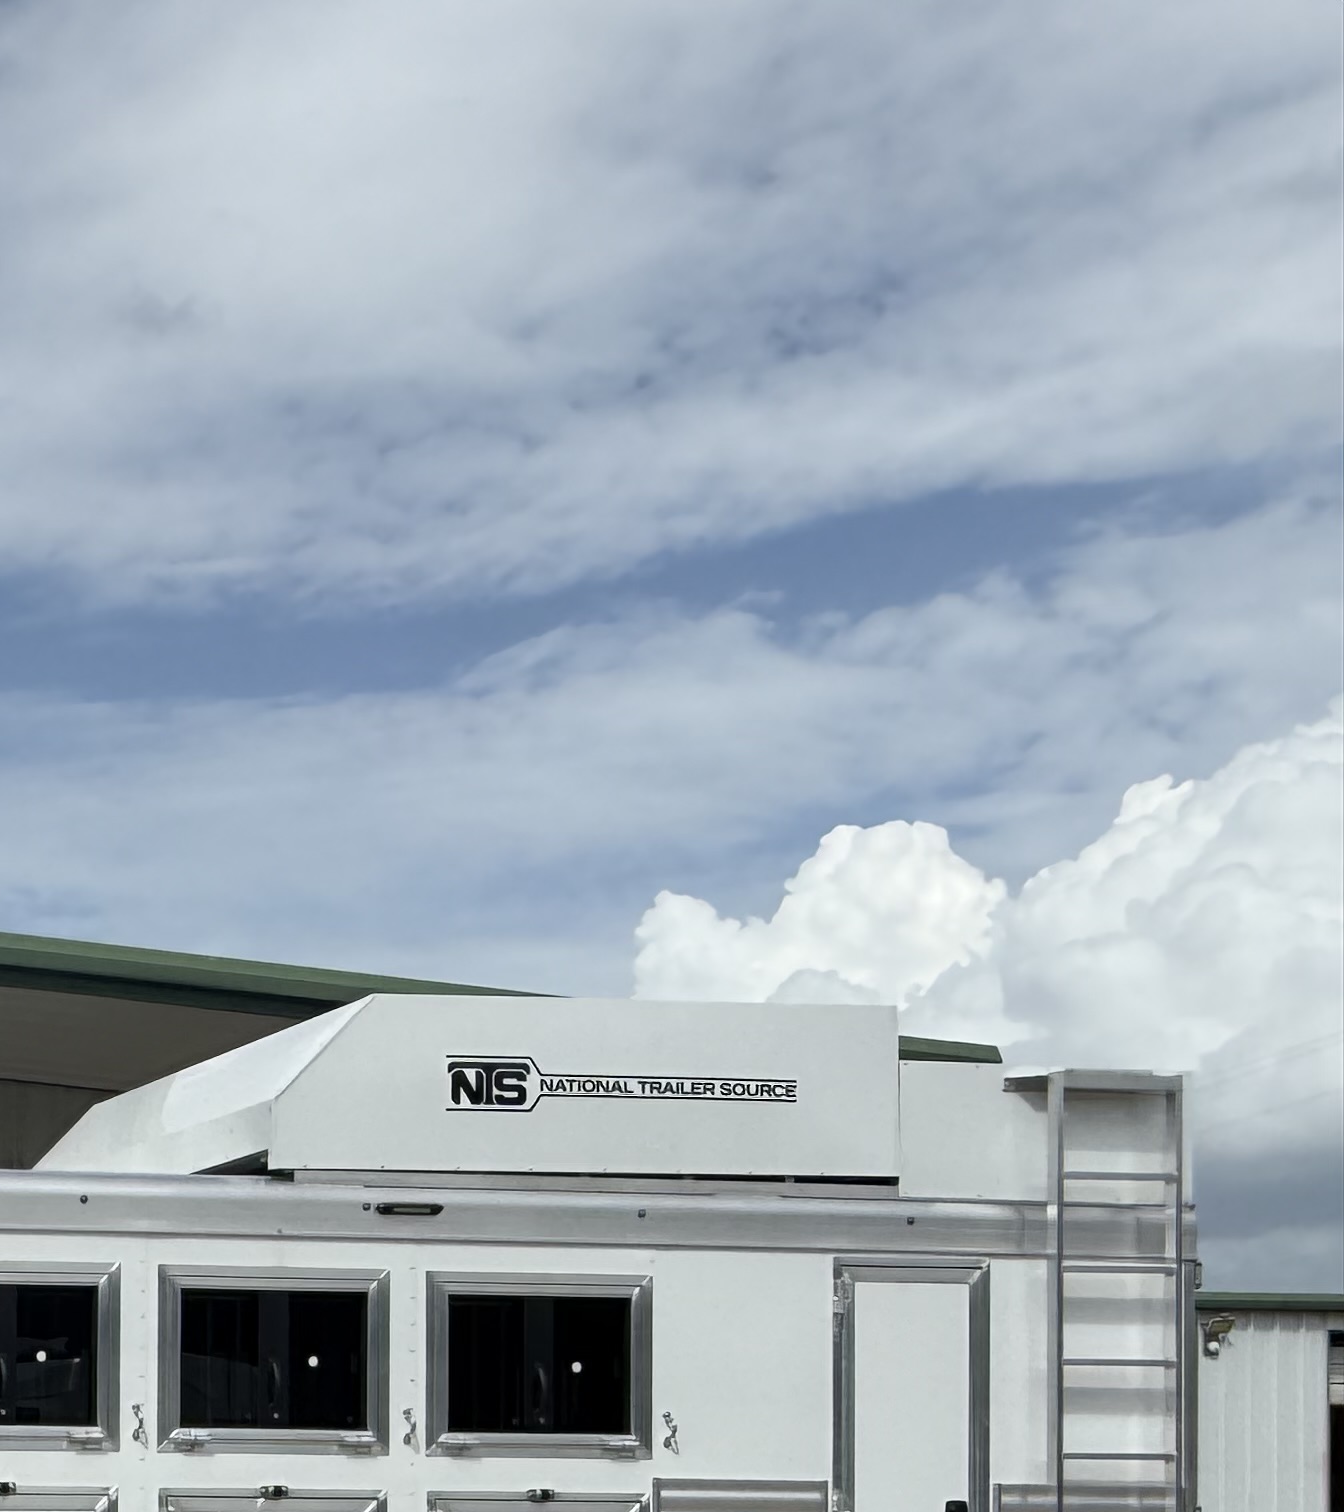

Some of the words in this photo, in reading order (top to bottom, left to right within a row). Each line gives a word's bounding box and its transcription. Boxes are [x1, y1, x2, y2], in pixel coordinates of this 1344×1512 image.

[447, 1061, 531, 1106] NTS
[540, 1079, 634, 1094] NATIONAL
[638, 1080, 715, 1096] TRAILER
[719, 1082, 798, 1098] SOURCE
